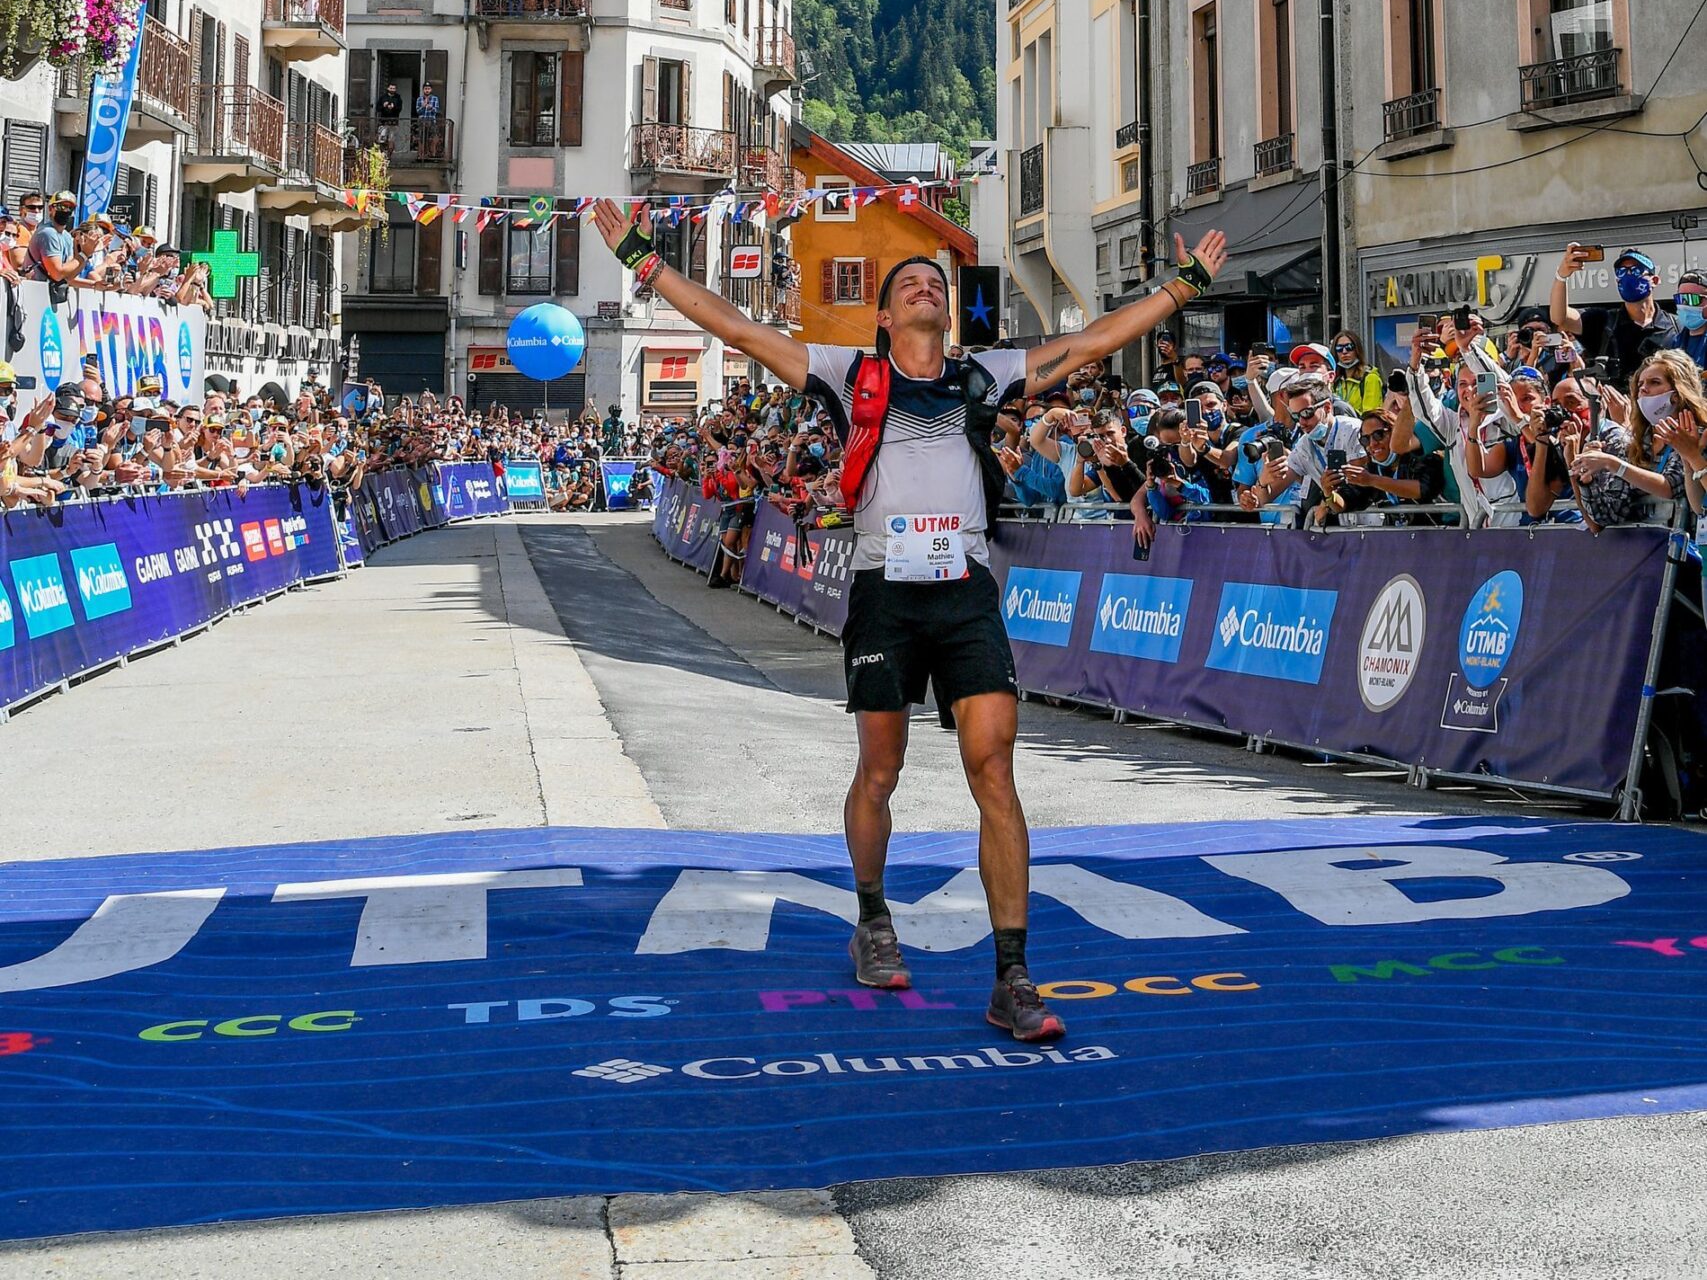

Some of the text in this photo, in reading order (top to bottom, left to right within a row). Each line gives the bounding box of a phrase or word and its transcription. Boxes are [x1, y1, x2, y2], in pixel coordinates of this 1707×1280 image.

[510, 336, 548, 348] Columbia
[914, 516, 960, 533] UTMB
[927, 553, 955, 561] Mathieu
[932, 537, 950, 552] 59
[88, 563, 128, 596] Columbia
[1017, 588, 1073, 624] Columbia
[1111, 596, 1182, 637] Columbia
[1239, 609, 1325, 656] Columbia
[1466, 630, 1507, 655] UTMB
[1363, 655, 1411, 676] CHAMONIX
[1461, 700, 1489, 716] Columbi
[1328, 946, 1567, 983] MCC
[1036, 972, 1261, 1000] OCC
[447, 995, 674, 1024] TDS
[758, 989, 957, 1013] PTL
[138, 1010, 357, 1042] CCC
[681, 1045, 1120, 1081] Columbia
